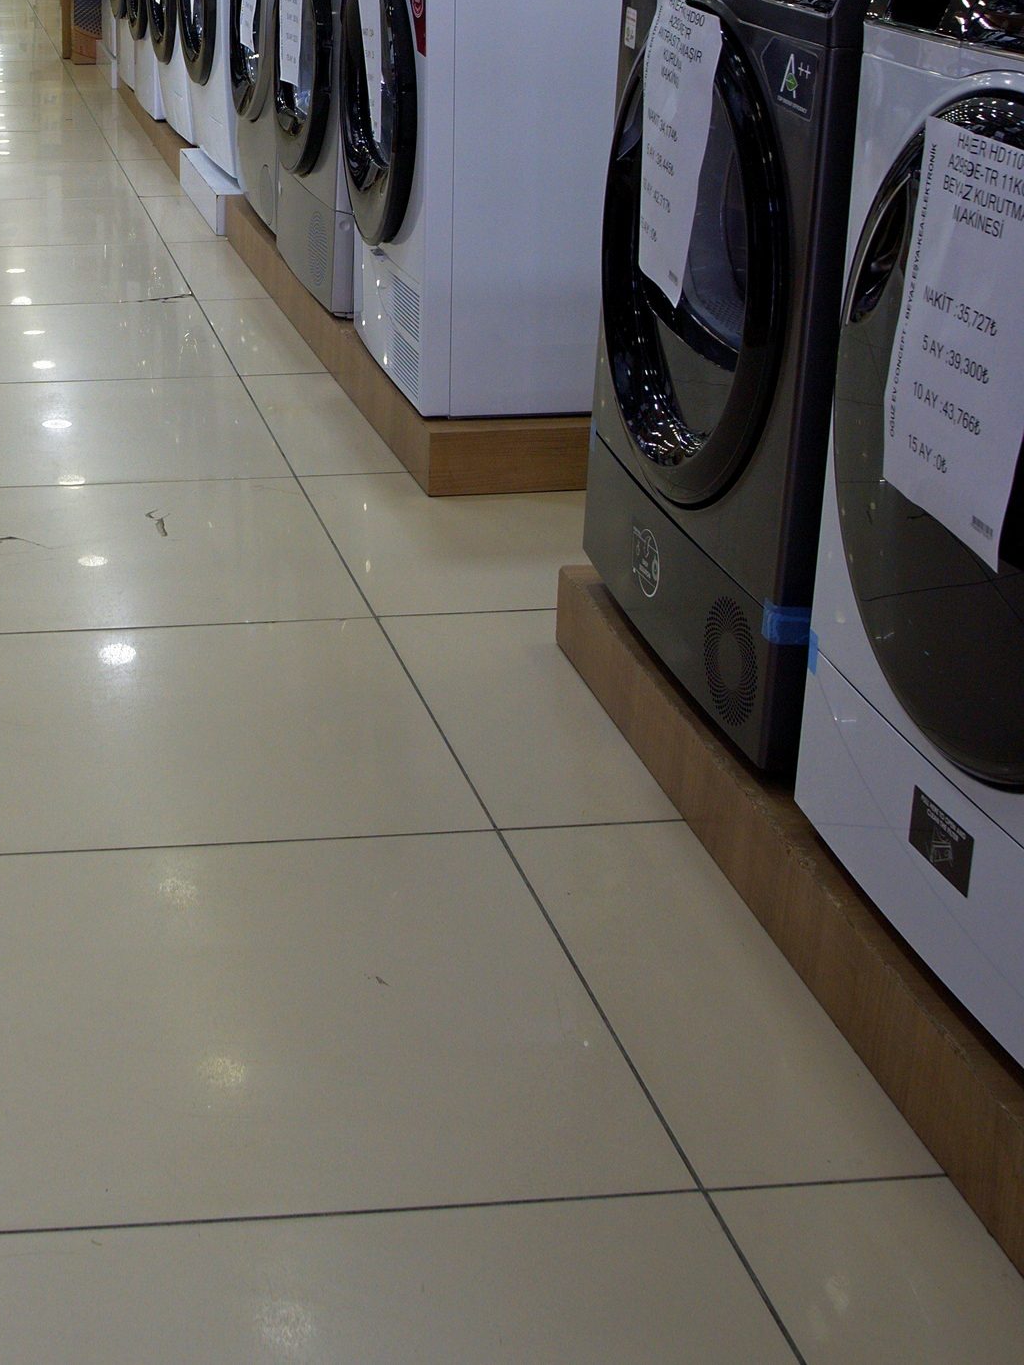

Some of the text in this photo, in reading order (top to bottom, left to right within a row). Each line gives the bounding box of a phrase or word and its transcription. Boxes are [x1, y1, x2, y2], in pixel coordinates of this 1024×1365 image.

[923, 285, 954, 314] NAKİT
[922, 335, 929, 351] 5
[930, 342, 945, 359] AY
[890, 392, 897, 411] EV
[894, 334, 907, 391] CONCEPT
[913, 381, 923, 401] 10
[923, 389, 938, 405] AY
[908, 433, 918, 453] 15
[918, 441, 933, 457] AY
